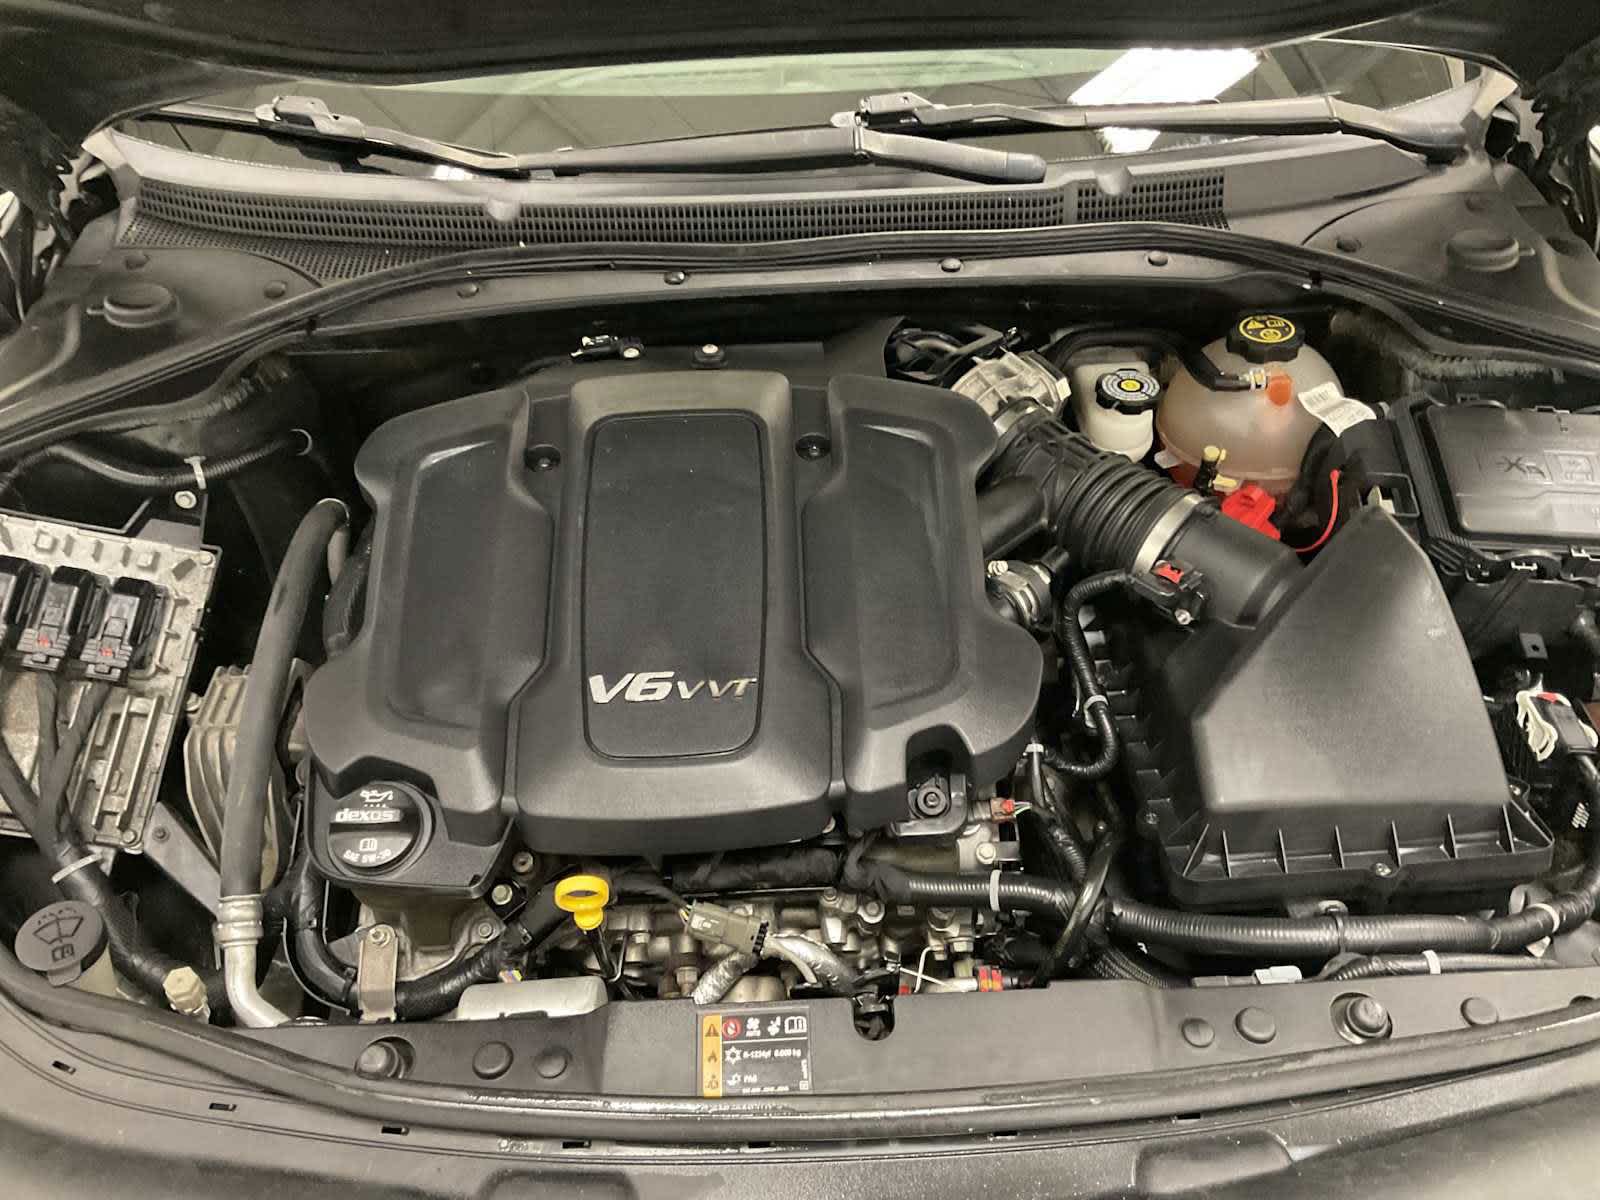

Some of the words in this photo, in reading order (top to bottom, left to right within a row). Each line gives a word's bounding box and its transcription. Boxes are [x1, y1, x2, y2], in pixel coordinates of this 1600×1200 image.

[589, 671, 675, 704] V6
[677, 678, 757, 700] VVT
[335, 808, 394, 822] dexos
